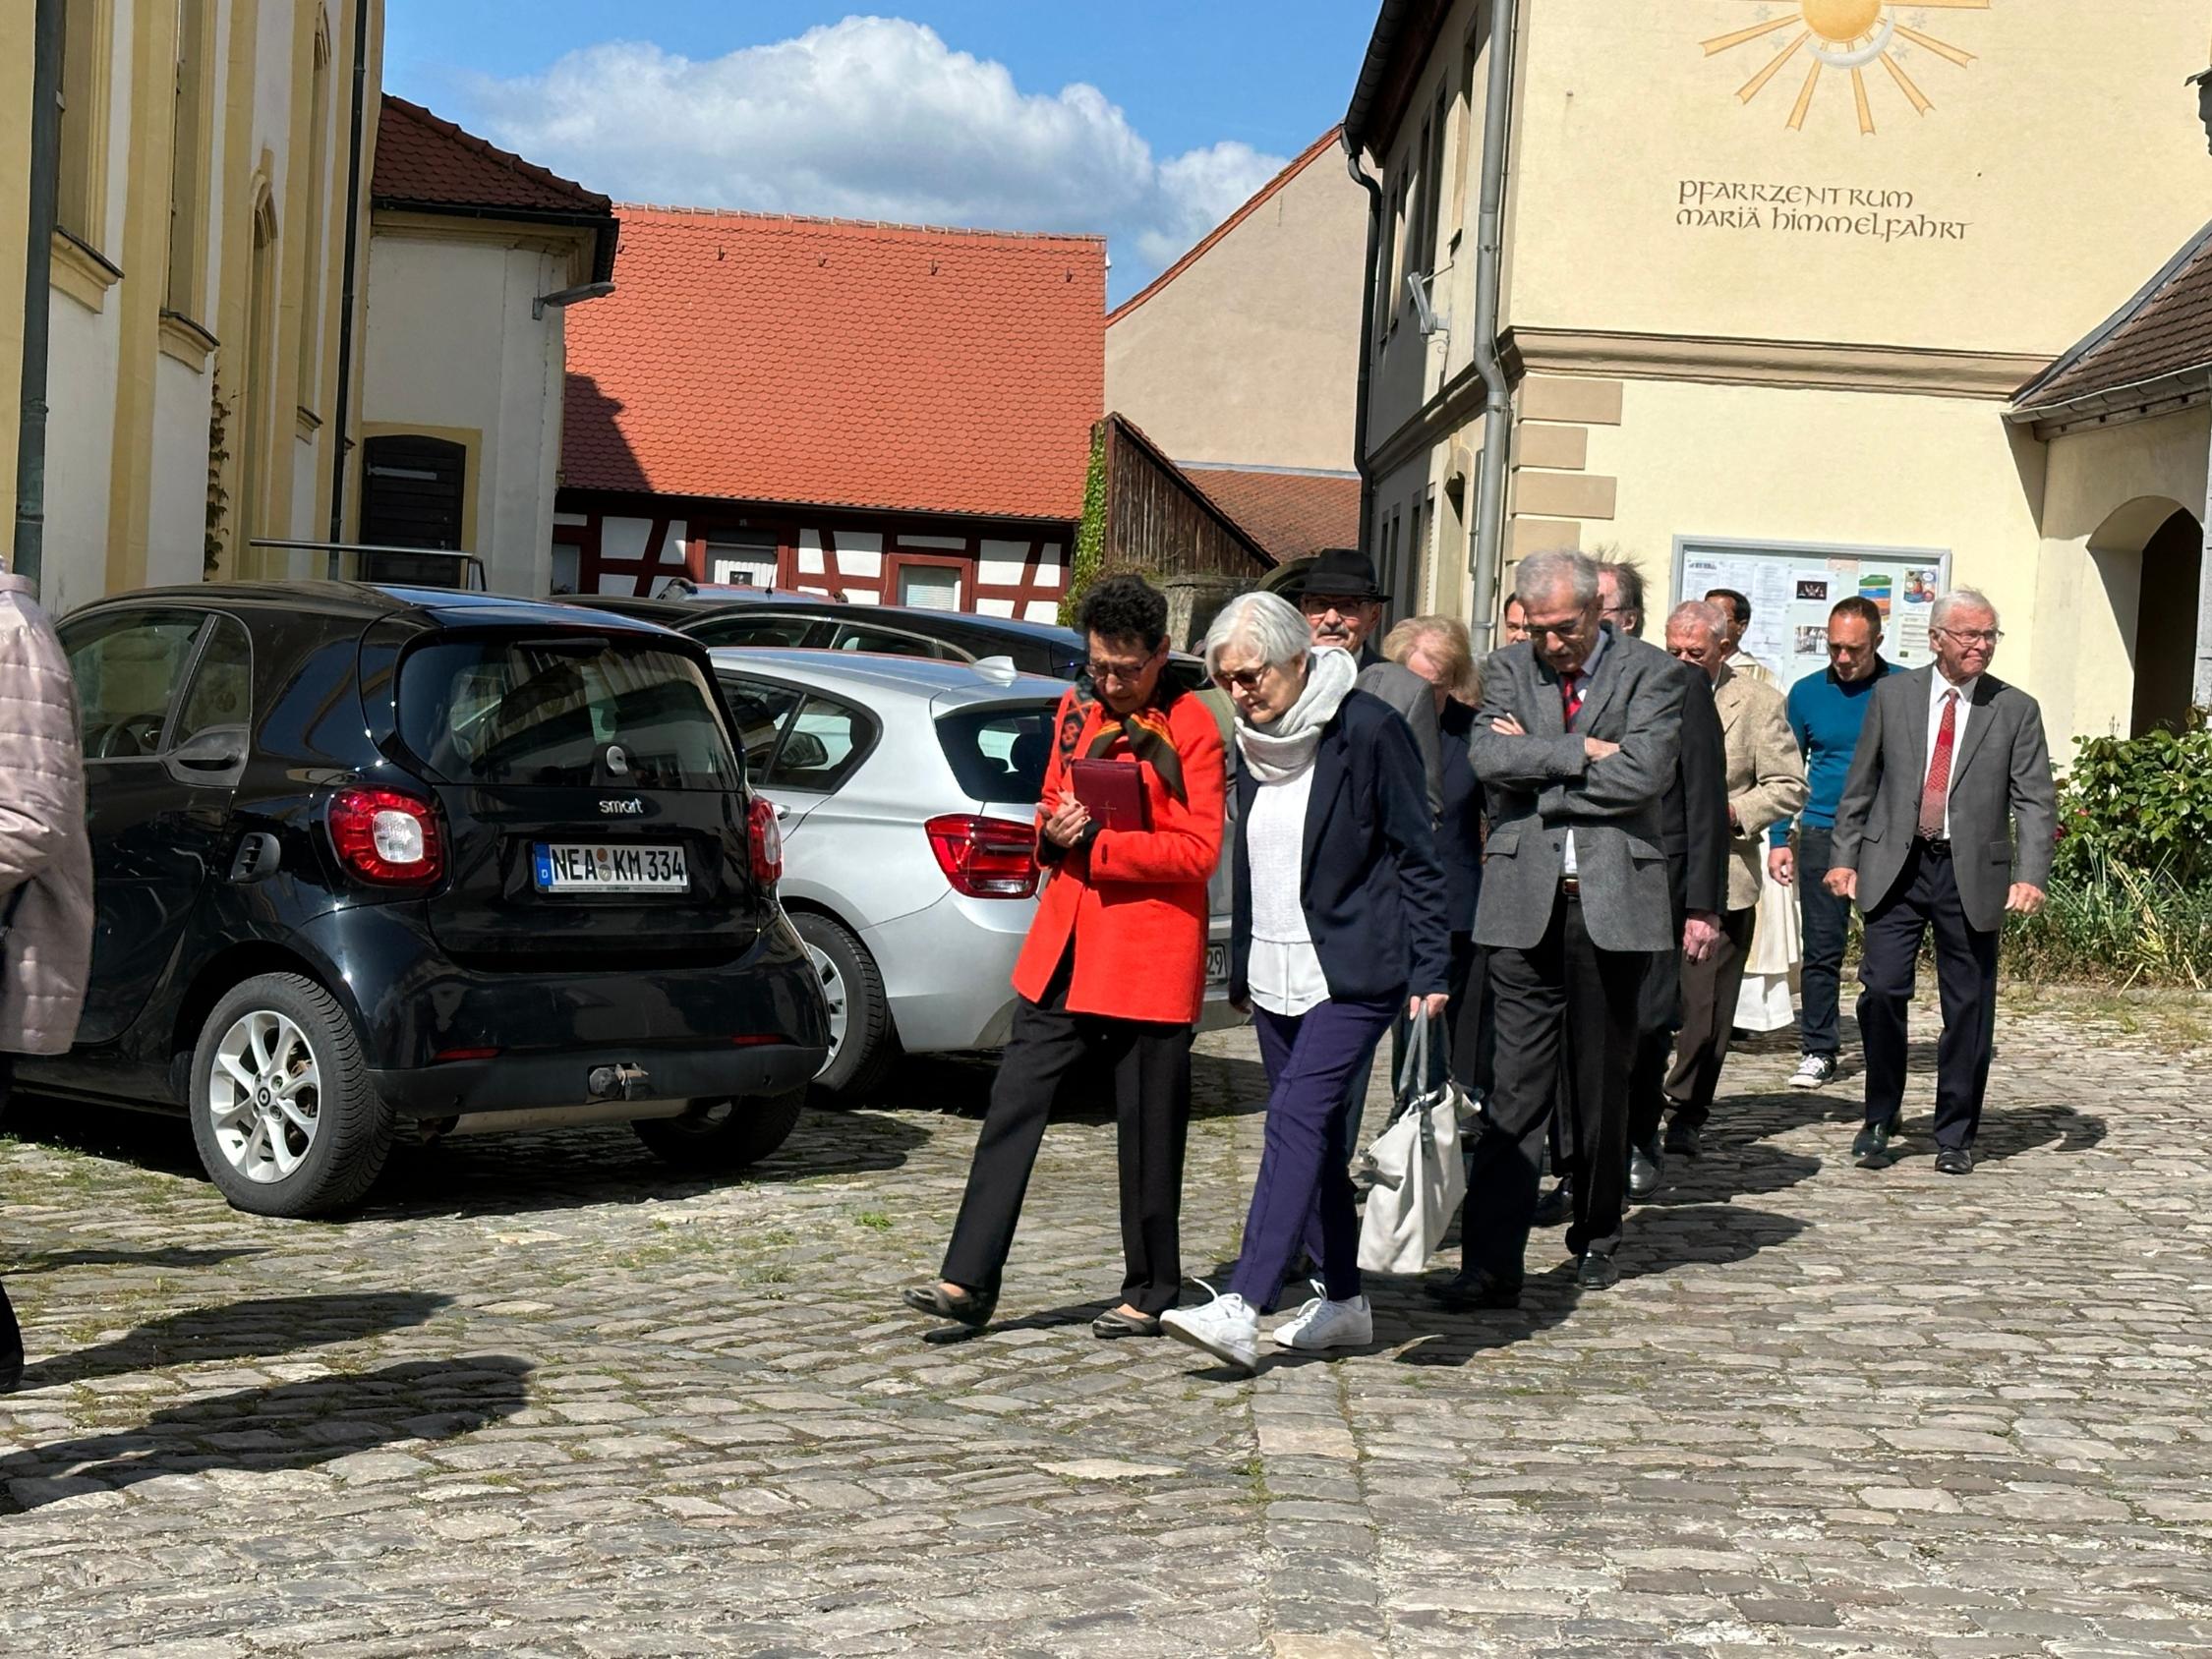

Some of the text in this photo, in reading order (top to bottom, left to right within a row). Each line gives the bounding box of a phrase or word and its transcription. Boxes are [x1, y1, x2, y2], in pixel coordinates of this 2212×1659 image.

[599, 798, 644, 814] smart
[552, 848, 598, 881] NEA
[542, 868, 549, 879] D
